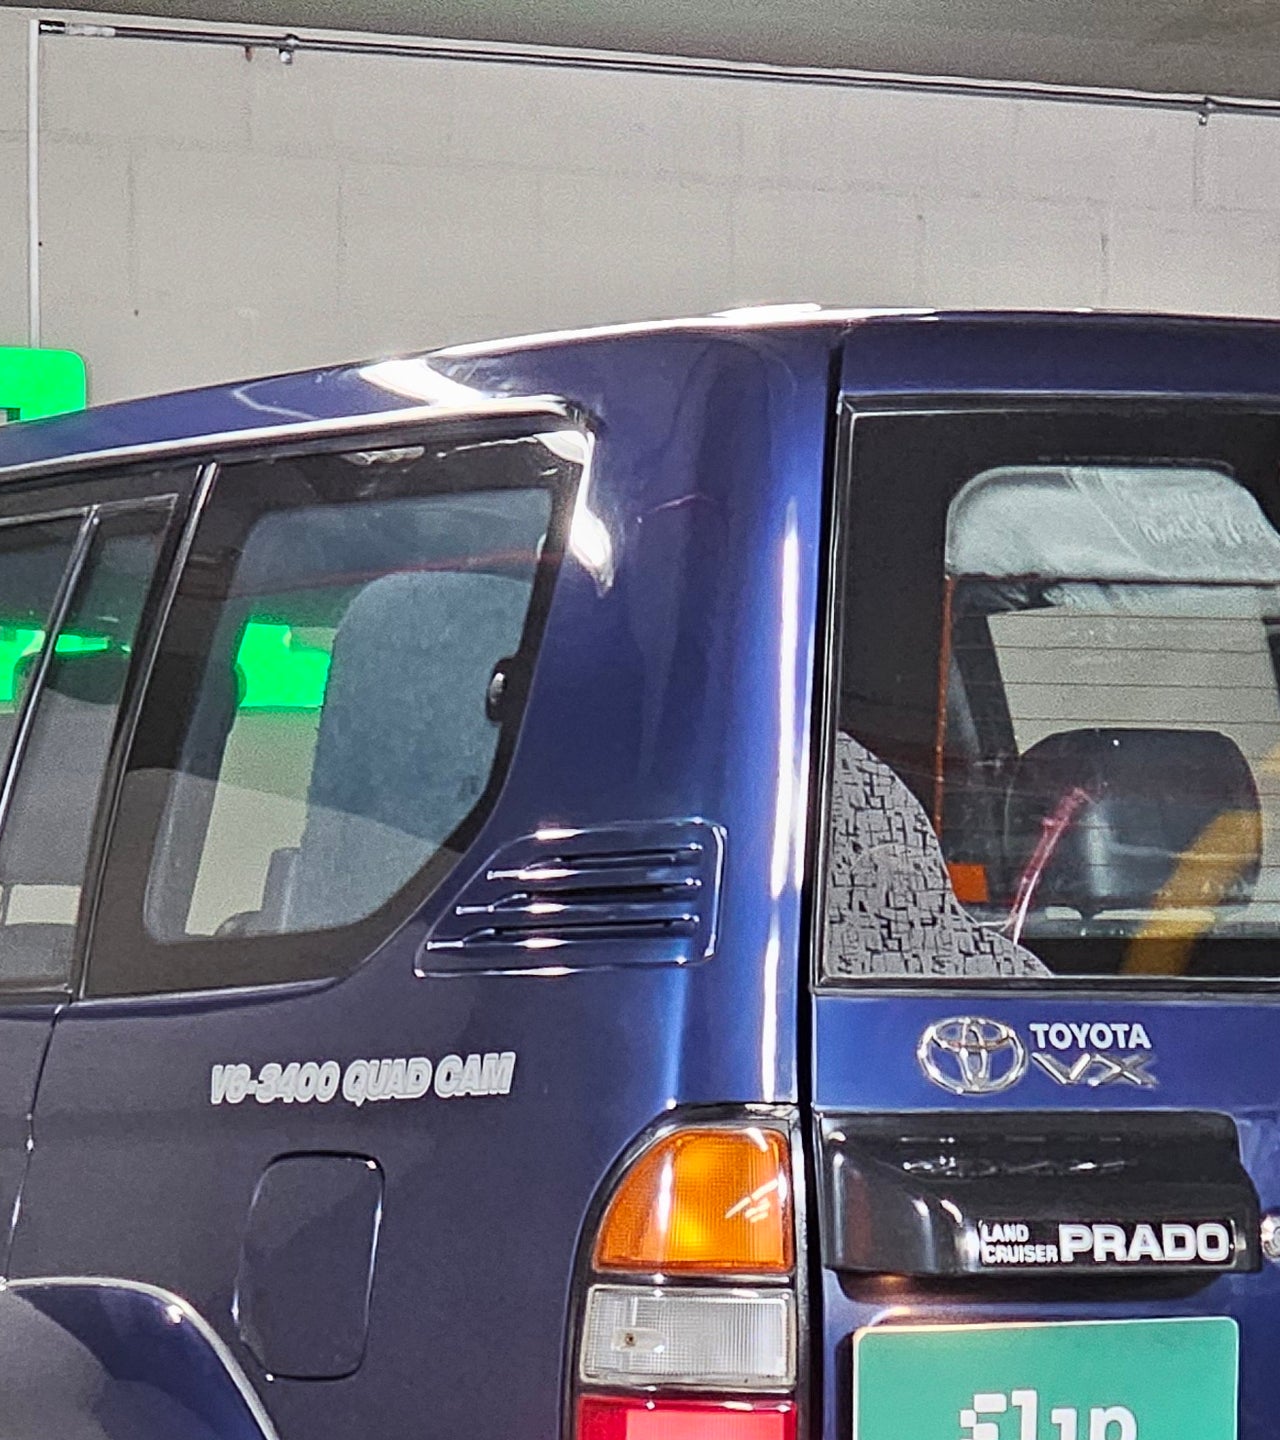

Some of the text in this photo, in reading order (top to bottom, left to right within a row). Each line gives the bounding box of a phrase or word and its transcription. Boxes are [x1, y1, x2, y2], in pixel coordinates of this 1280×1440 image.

[1029, 1022, 1152, 1050] TOYOTA
[211, 1052, 516, 1106] V6-3400 QUAD CAM
[1031, 1052, 1158, 1088] VX
[982, 1224, 1029, 1243] LAND
[1058, 1223, 1230, 1262] PRADO
[985, 1244, 1059, 1264] CRUISER
